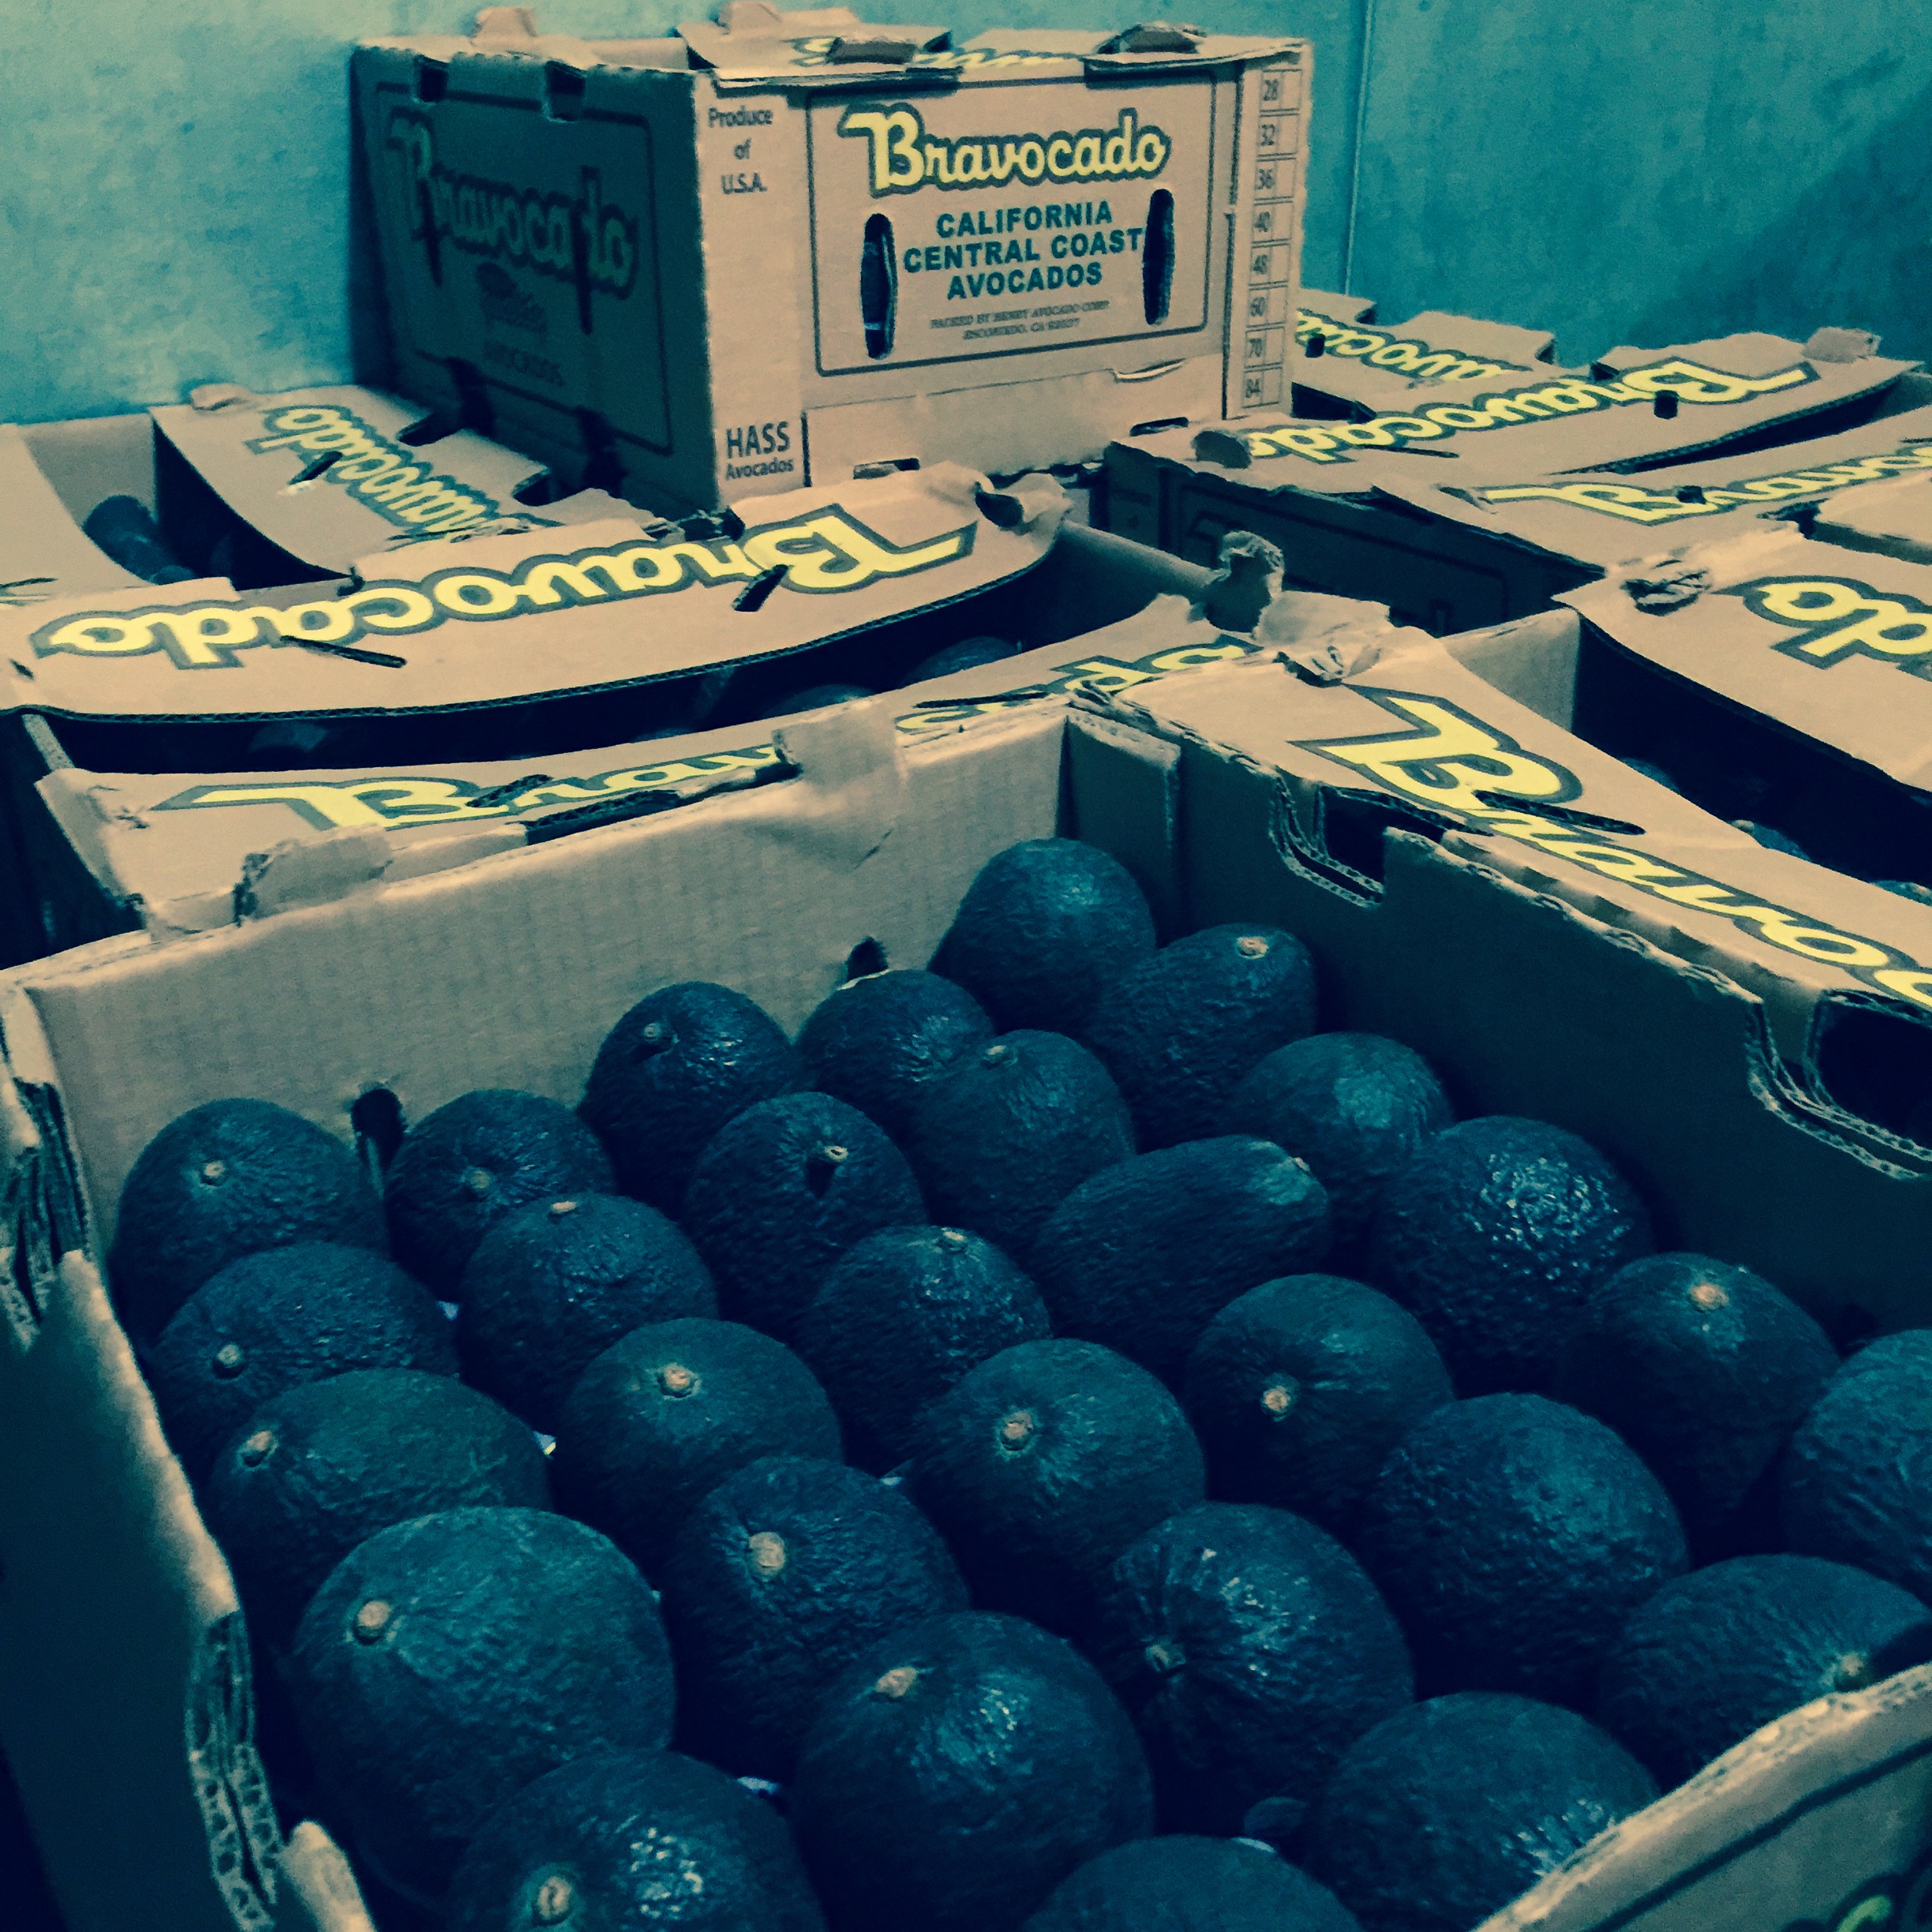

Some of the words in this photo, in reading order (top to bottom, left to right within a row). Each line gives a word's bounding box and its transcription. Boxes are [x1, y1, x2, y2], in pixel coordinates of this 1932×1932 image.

[709, 104, 773, 128] Produce
[733, 137, 752, 160] of
[837, 102, 1171, 197] Bravocado
[936, 200, 1113, 238] CALIFORNIA
[903, 238, 1042, 273] CENTRAL
[1050, 227, 1144, 259] COAST
[947, 261, 1103, 301] AVOCADOS
[726, 421, 790, 459] HASS
[726, 457, 794, 481] Avocados
[29, 504, 977, 670] Bravocado
